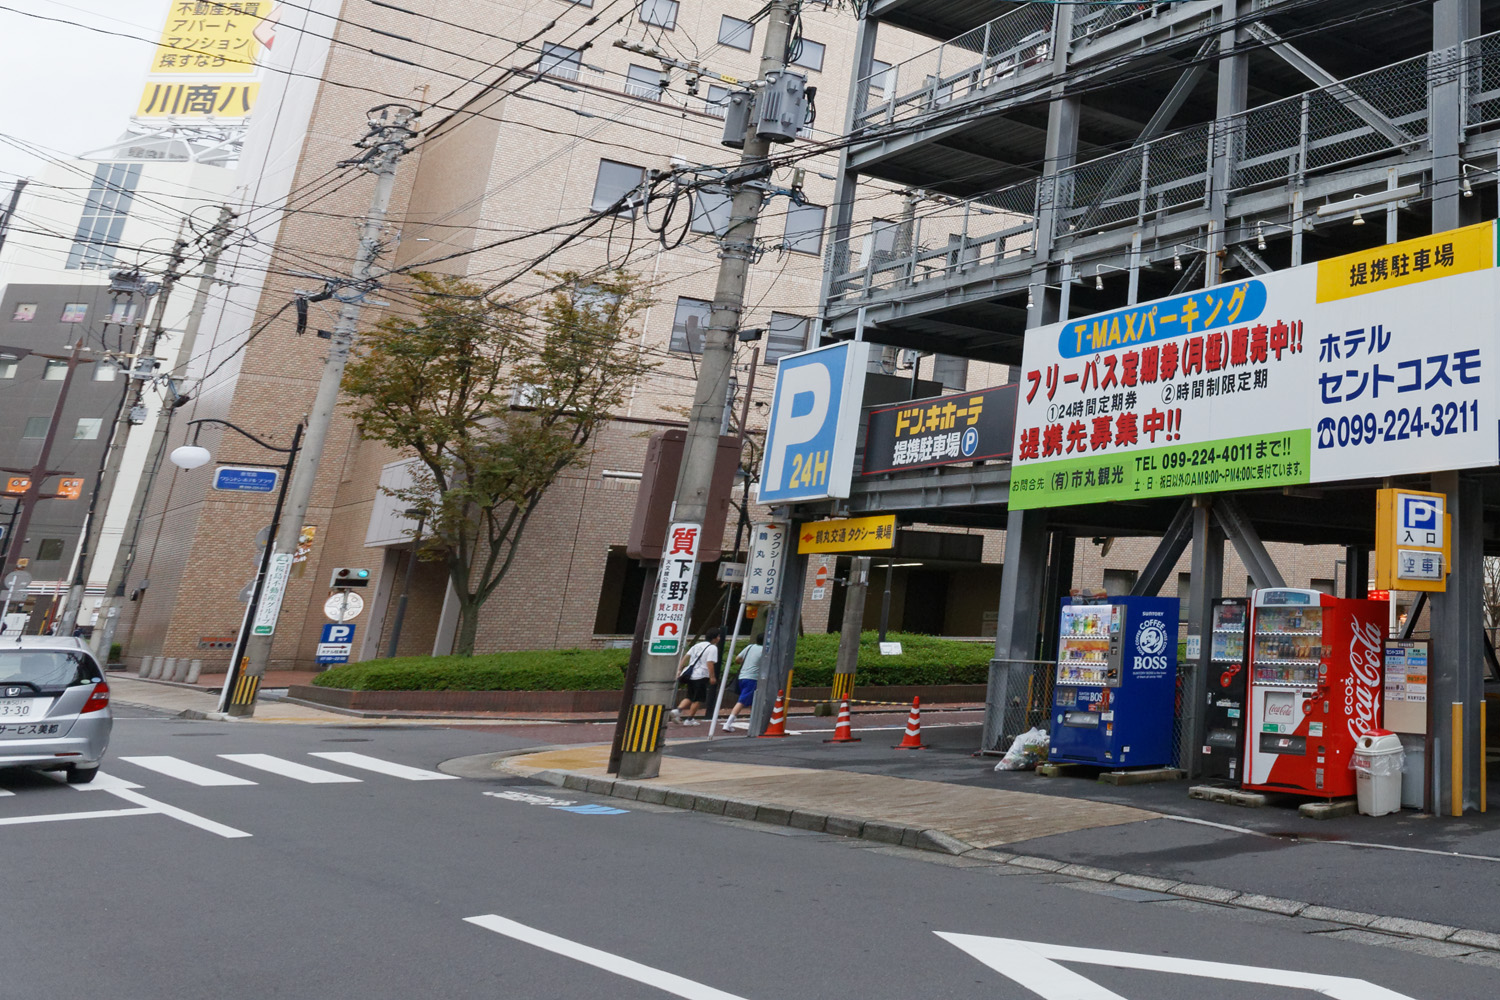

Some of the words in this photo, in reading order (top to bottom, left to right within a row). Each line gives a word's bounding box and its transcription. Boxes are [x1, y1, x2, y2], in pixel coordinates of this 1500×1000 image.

[176, 1, 260, 16] 不動産売買
[171, 19, 237, 32] アパート
[168, 37, 249, 50] マンション
[1349, 242, 1454, 287] 提携駐車場
[1073, 282, 1250, 354] T-MAXパーキング
[1319, 324, 1391, 363] ホテル
[1318, 348, 1482, 405] セントコスモ
[764, 362, 832, 493] P
[1337, 399, 1479, 448] 099-224-3211
[892, 432, 961, 467] 提携駐車場
[789, 450, 830, 490] 24H
[1135, 455, 1158, 473] TEL
[1011, 477, 1045, 492] お問合先
[1408, 501, 1432, 527] P
[669, 527, 697, 556] 質
[848, 525, 893, 542] タクシー乗場
[1403, 530, 1436, 545] 入口
[764, 532, 782, 595] タクシーのりば
[1403, 557, 1434, 575] 空車
[667, 559, 693, 601] 下野
[328, 625, 350, 642] P
[1139, 618, 1165, 631] COFFEE
[1133, 656, 1167, 670] BOSS
[1347, 613, 1381, 744] Coca-Cola
[1089, 692, 1103, 702] BOS
[0, 706, 30, 715] 3-30
[1268, 704, 1294, 717] Coca-Cola
